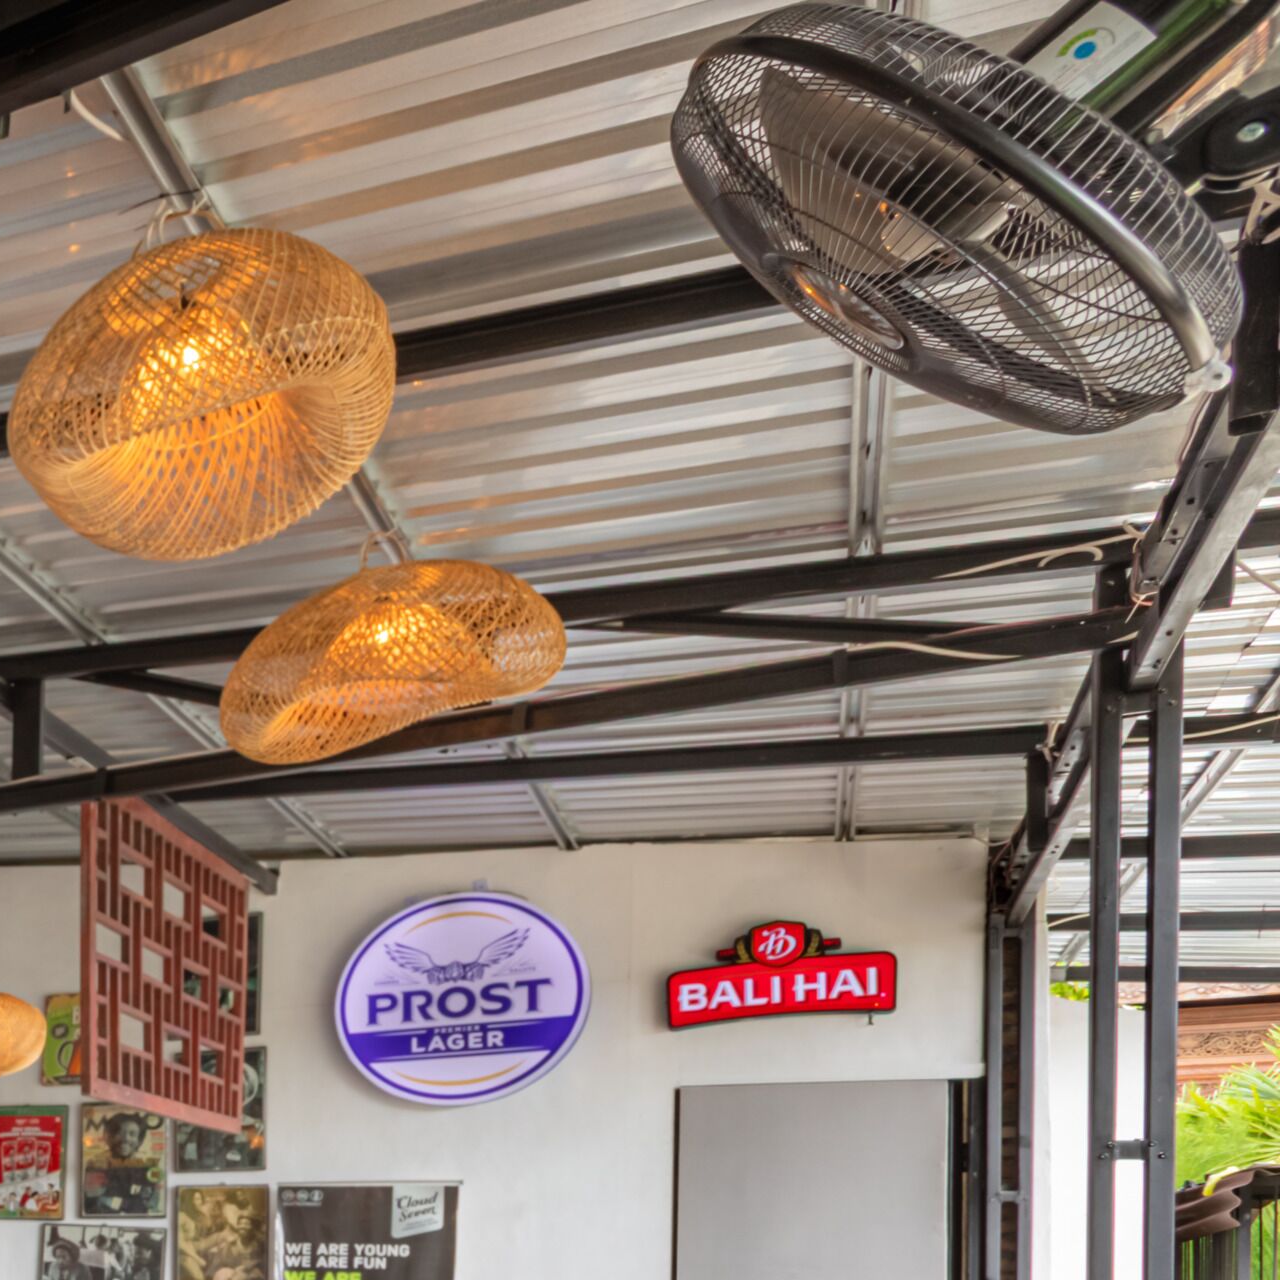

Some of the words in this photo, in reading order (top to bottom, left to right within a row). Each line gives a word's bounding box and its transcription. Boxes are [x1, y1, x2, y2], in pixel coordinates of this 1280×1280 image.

[677, 975, 781, 1012] BALI
[792, 966, 878, 1003] HAI
[366, 977, 553, 1026] PROST
[433, 1025, 481, 1034] PREMIER
[410, 1030, 505, 1053] LAGER
[396, 1191, 439, 1210] Cloud
[285, 1242, 312, 1255] WE
[316, 1242, 349, 1256] ARE
[354, 1243, 411, 1257] YOUNG
[285, 1256, 311, 1268] WE
[316, 1256, 348, 1269] ARE
[353, 1257, 387, 1269] FUN
